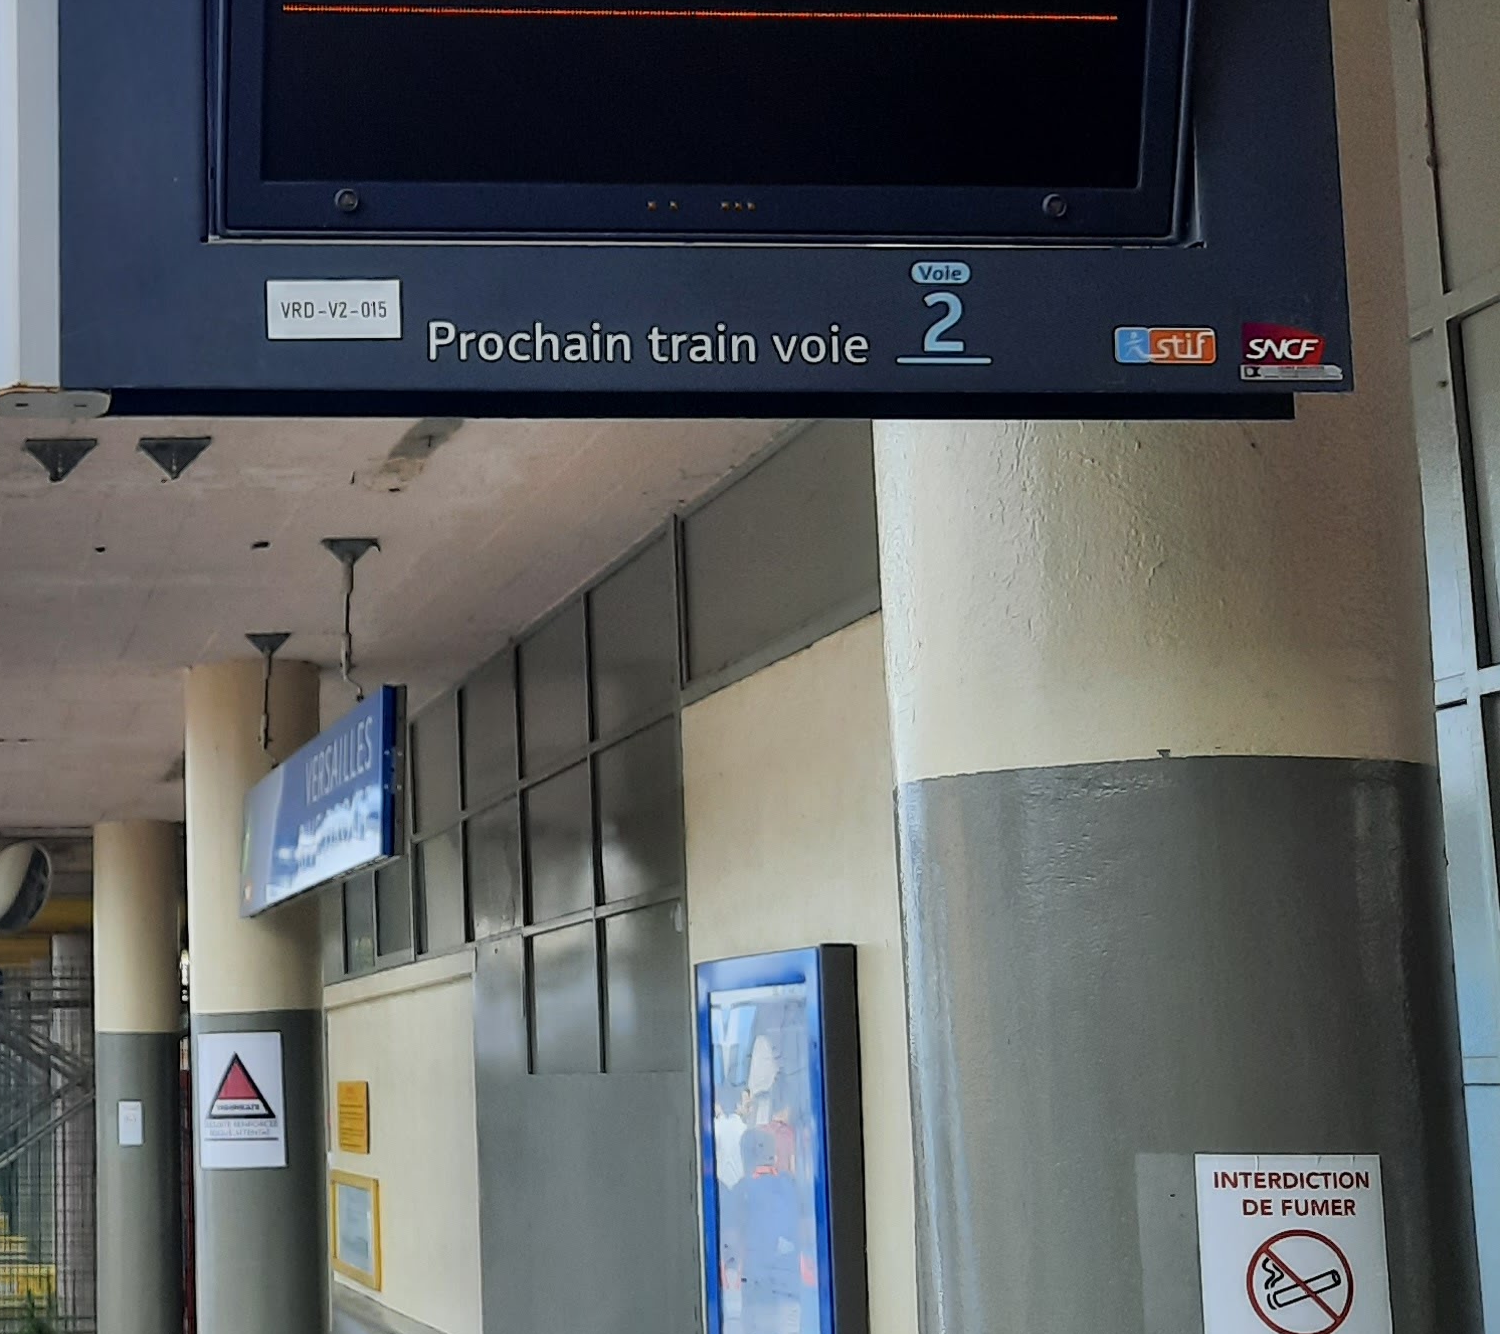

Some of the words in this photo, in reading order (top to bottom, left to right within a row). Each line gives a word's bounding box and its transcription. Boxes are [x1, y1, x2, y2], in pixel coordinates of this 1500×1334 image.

[917, 266, 963, 283] Voie
[427, 321, 632, 362] Prochain
[647, 323, 757, 363] train
[772, 323, 870, 364] voie
[922, 291, 966, 353] 2
[1153, 331, 1215, 360] stif
[1245, 338, 1320, 361] SNCF
[305, 714, 374, 807] VERSAILLES
[1213, 1171, 1370, 1190] INTERDICTION
[1242, 1199, 1274, 1216] DE
[1281, 1199, 1357, 1217] FUMER
